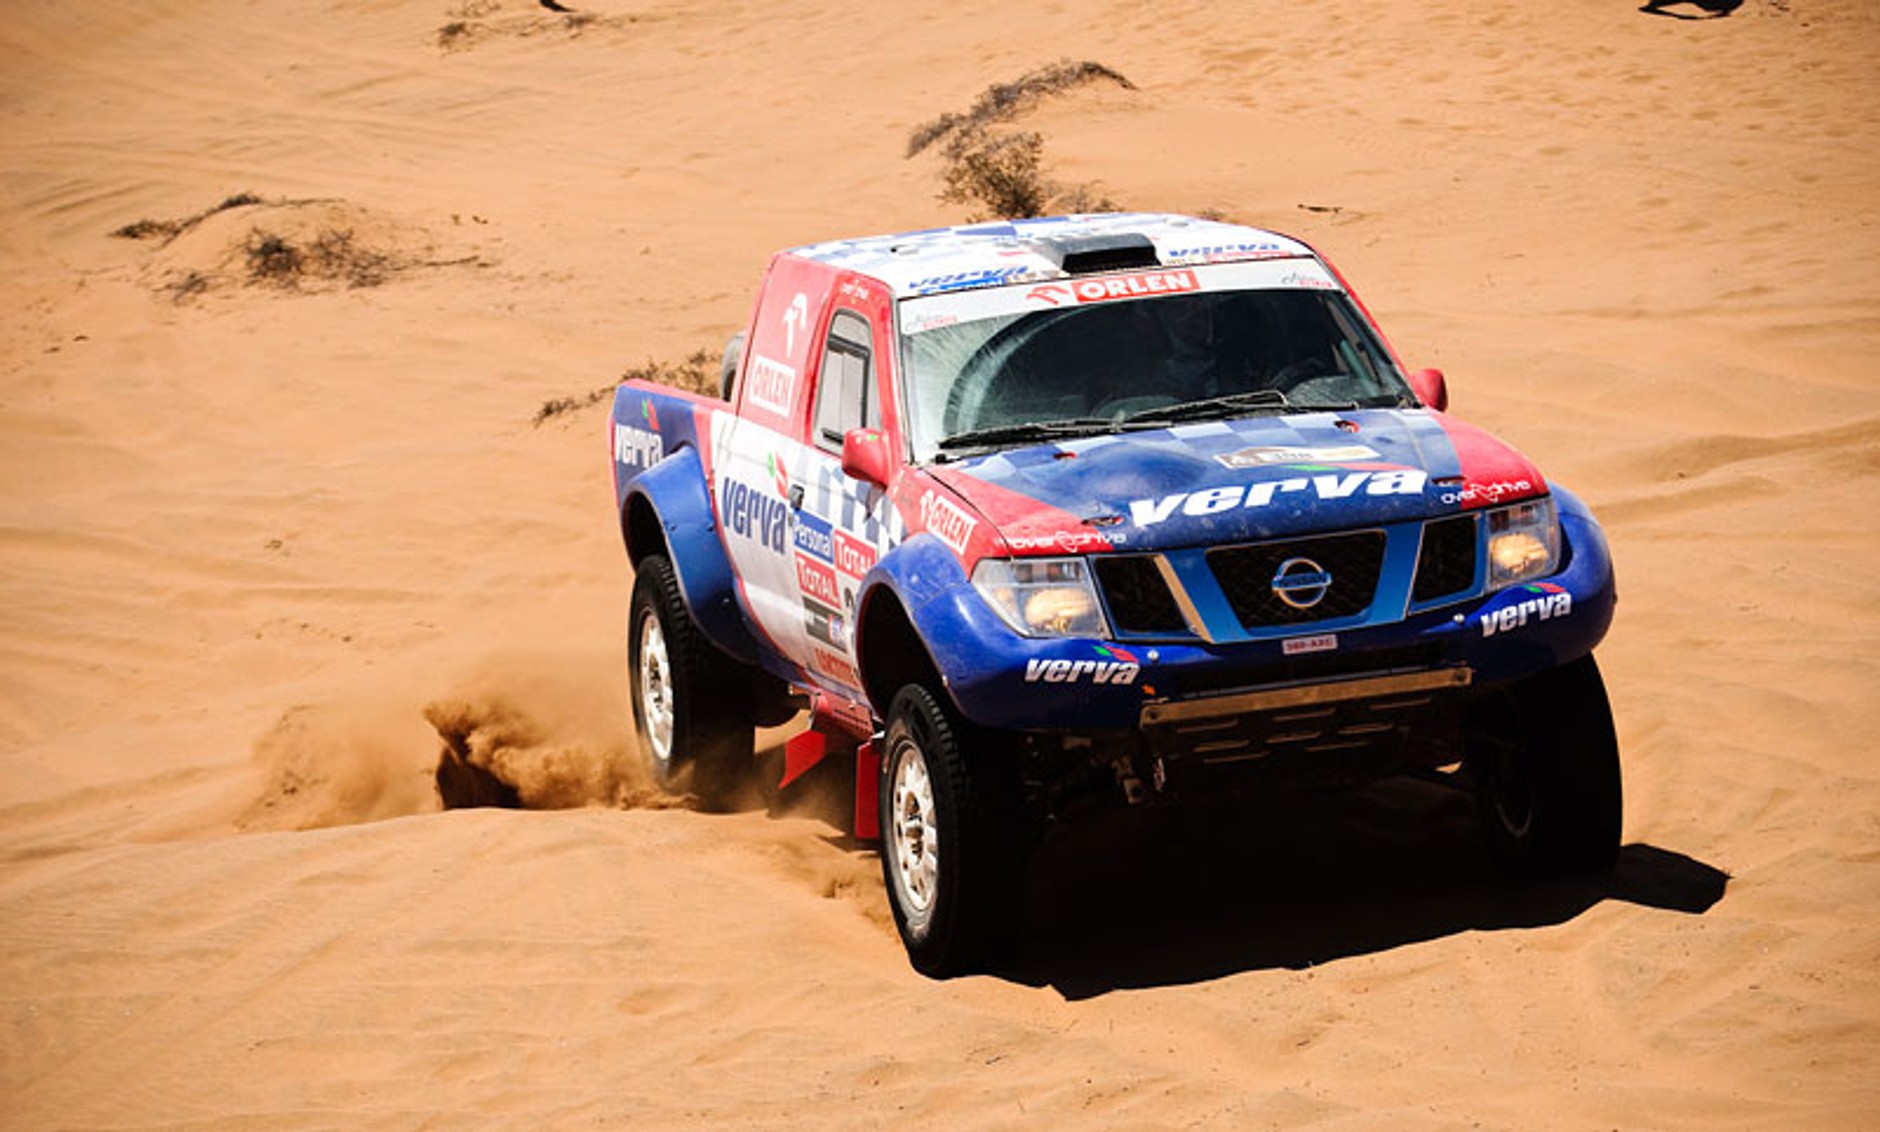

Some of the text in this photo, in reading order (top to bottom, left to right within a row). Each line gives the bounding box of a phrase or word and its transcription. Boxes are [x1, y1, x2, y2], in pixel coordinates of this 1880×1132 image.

[1079, 272, 1193, 299] ORLEN
[753, 361, 789, 409] ORLEN
[616, 423, 664, 468] verva
[721, 477, 787, 555] verva
[1129, 470, 1428, 527] verva
[932, 502, 972, 547] ORLEN
[799, 557, 837, 603] TOTAL
[1481, 592, 1572, 638] verva
[1024, 659, 1141, 685] verva
